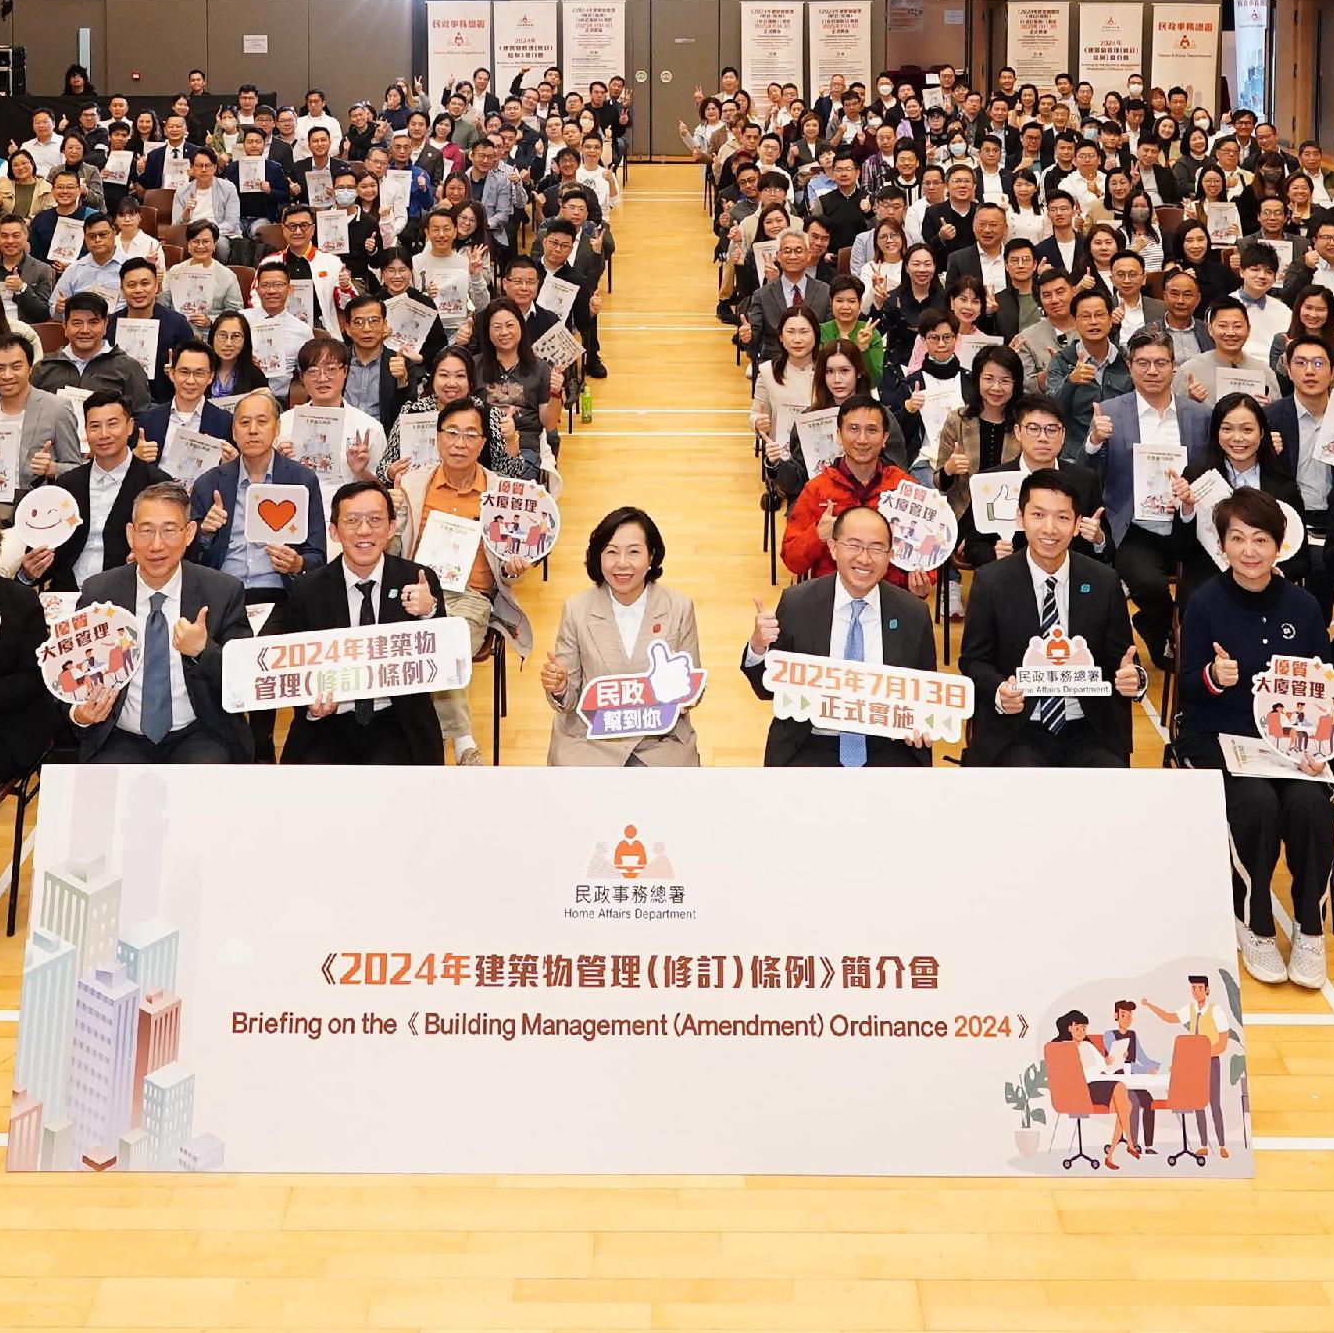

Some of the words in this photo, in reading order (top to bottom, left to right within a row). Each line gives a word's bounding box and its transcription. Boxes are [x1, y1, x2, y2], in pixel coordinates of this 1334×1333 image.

[482, 493, 539, 514] 大廈管理
[882, 493, 937, 523] 大廈管理
[40, 622, 111, 663] 大廈管理
[257, 630, 437, 672] 《2024年建築物
[254, 658, 439, 701] 管理(修訂)條例》
[1019, 670, 1099, 683] 民政事務總署
[1275, 659, 1308, 677] 優質
[597, 679, 646, 707] 民政
[772, 659, 966, 708] 2025年7月13日
[1036, 686, 1061, 694] Affairs
[1063, 686, 1109, 695] Department
[1256, 676, 1325, 700] 大廈管理
[603, 706, 662, 732] 幫到你
[819, 693, 915, 731] 正式實施
[575, 884, 685, 905] 民政事務總署
[564, 908, 595, 919] Home
[598, 908, 631, 919] Affairs
[634, 908, 696, 920] Department
[321, 952, 940, 989] 《2024年建築物管理(修訂)條例》簡介會
[232, 1011, 322, 1040] Briefing
[328, 1018, 356, 1035] on
[362, 1012, 397, 1035] the
[522, 1012, 668, 1041] Management
[673, 1012, 824, 1038] (Amendment)
[830, 1014, 948, 1038] Ordinance
